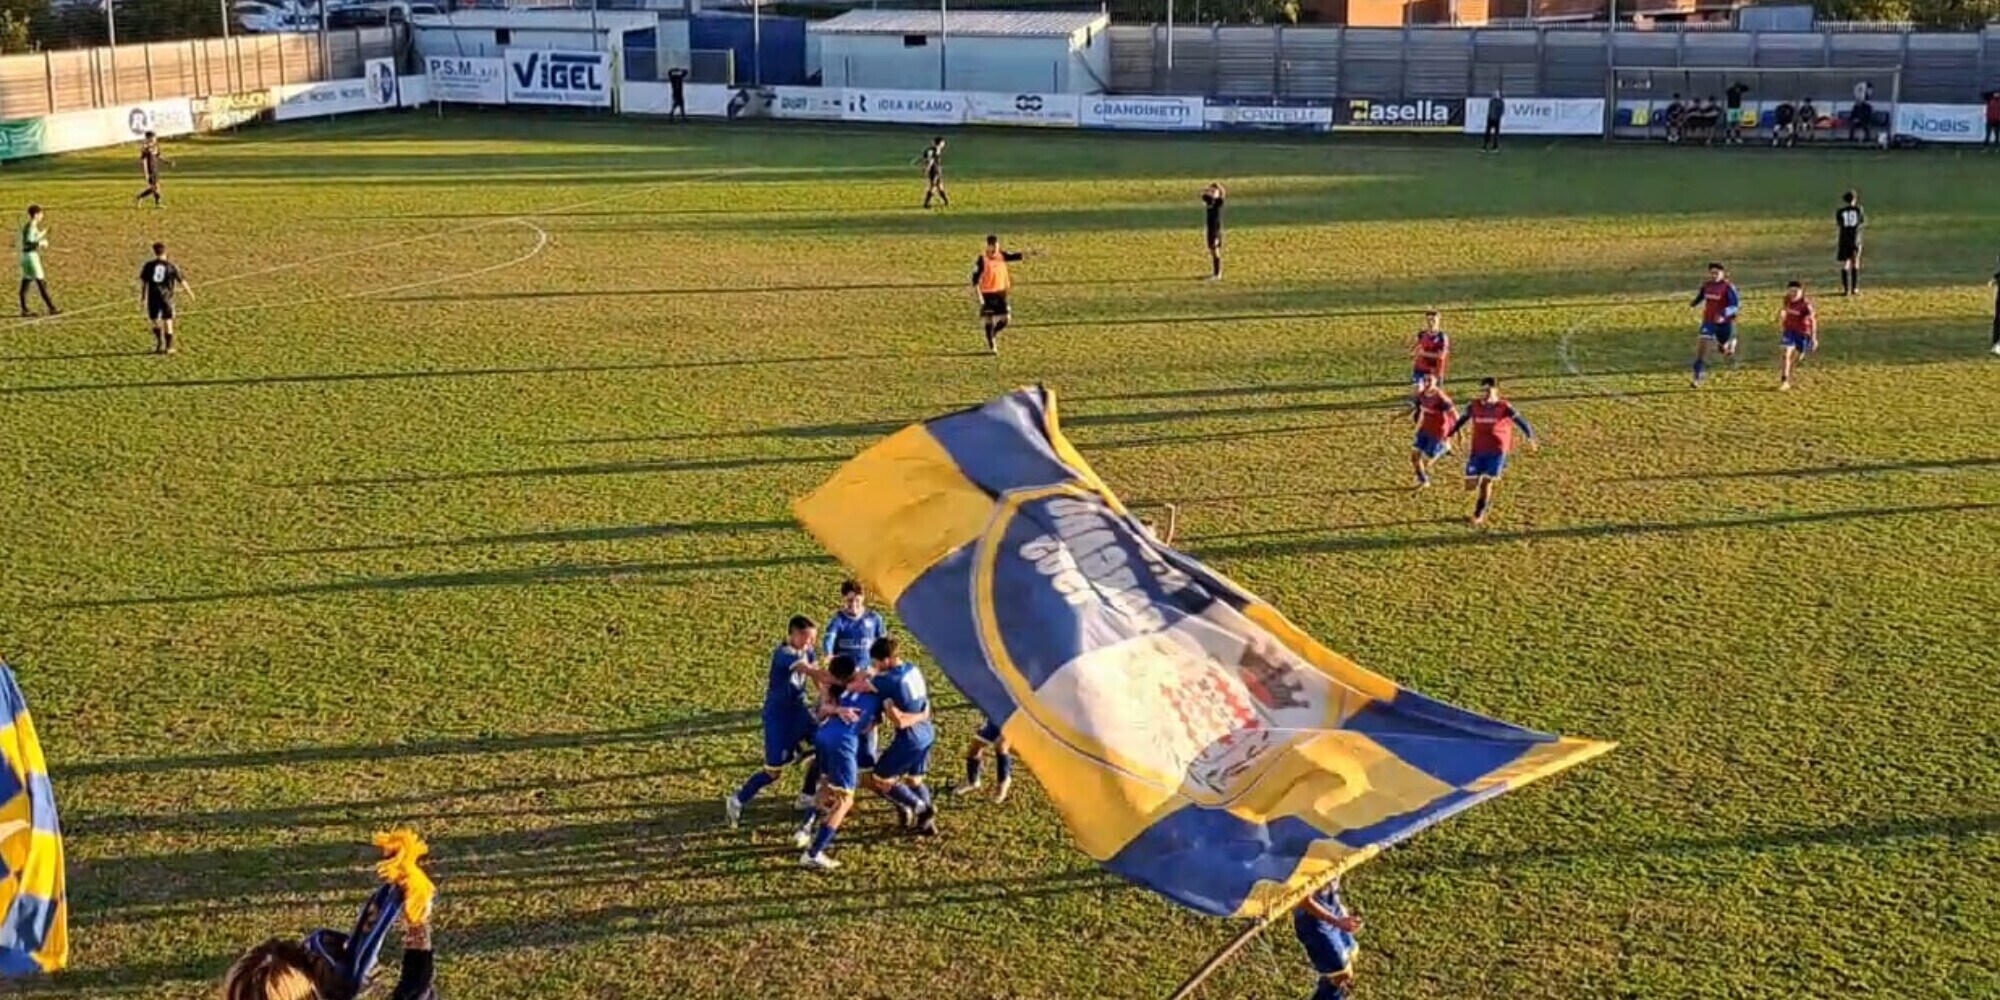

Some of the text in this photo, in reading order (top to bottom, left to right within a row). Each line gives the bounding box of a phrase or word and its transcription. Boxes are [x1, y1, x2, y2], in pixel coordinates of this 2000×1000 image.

[512, 52, 603, 91] VIGEL
[878, 99, 903, 111] IDEA
[1093, 102, 1190, 116] GRANDINETTI
[1512, 103, 1552, 117] Wire
[1911, 118, 1971, 132] NOBIS
